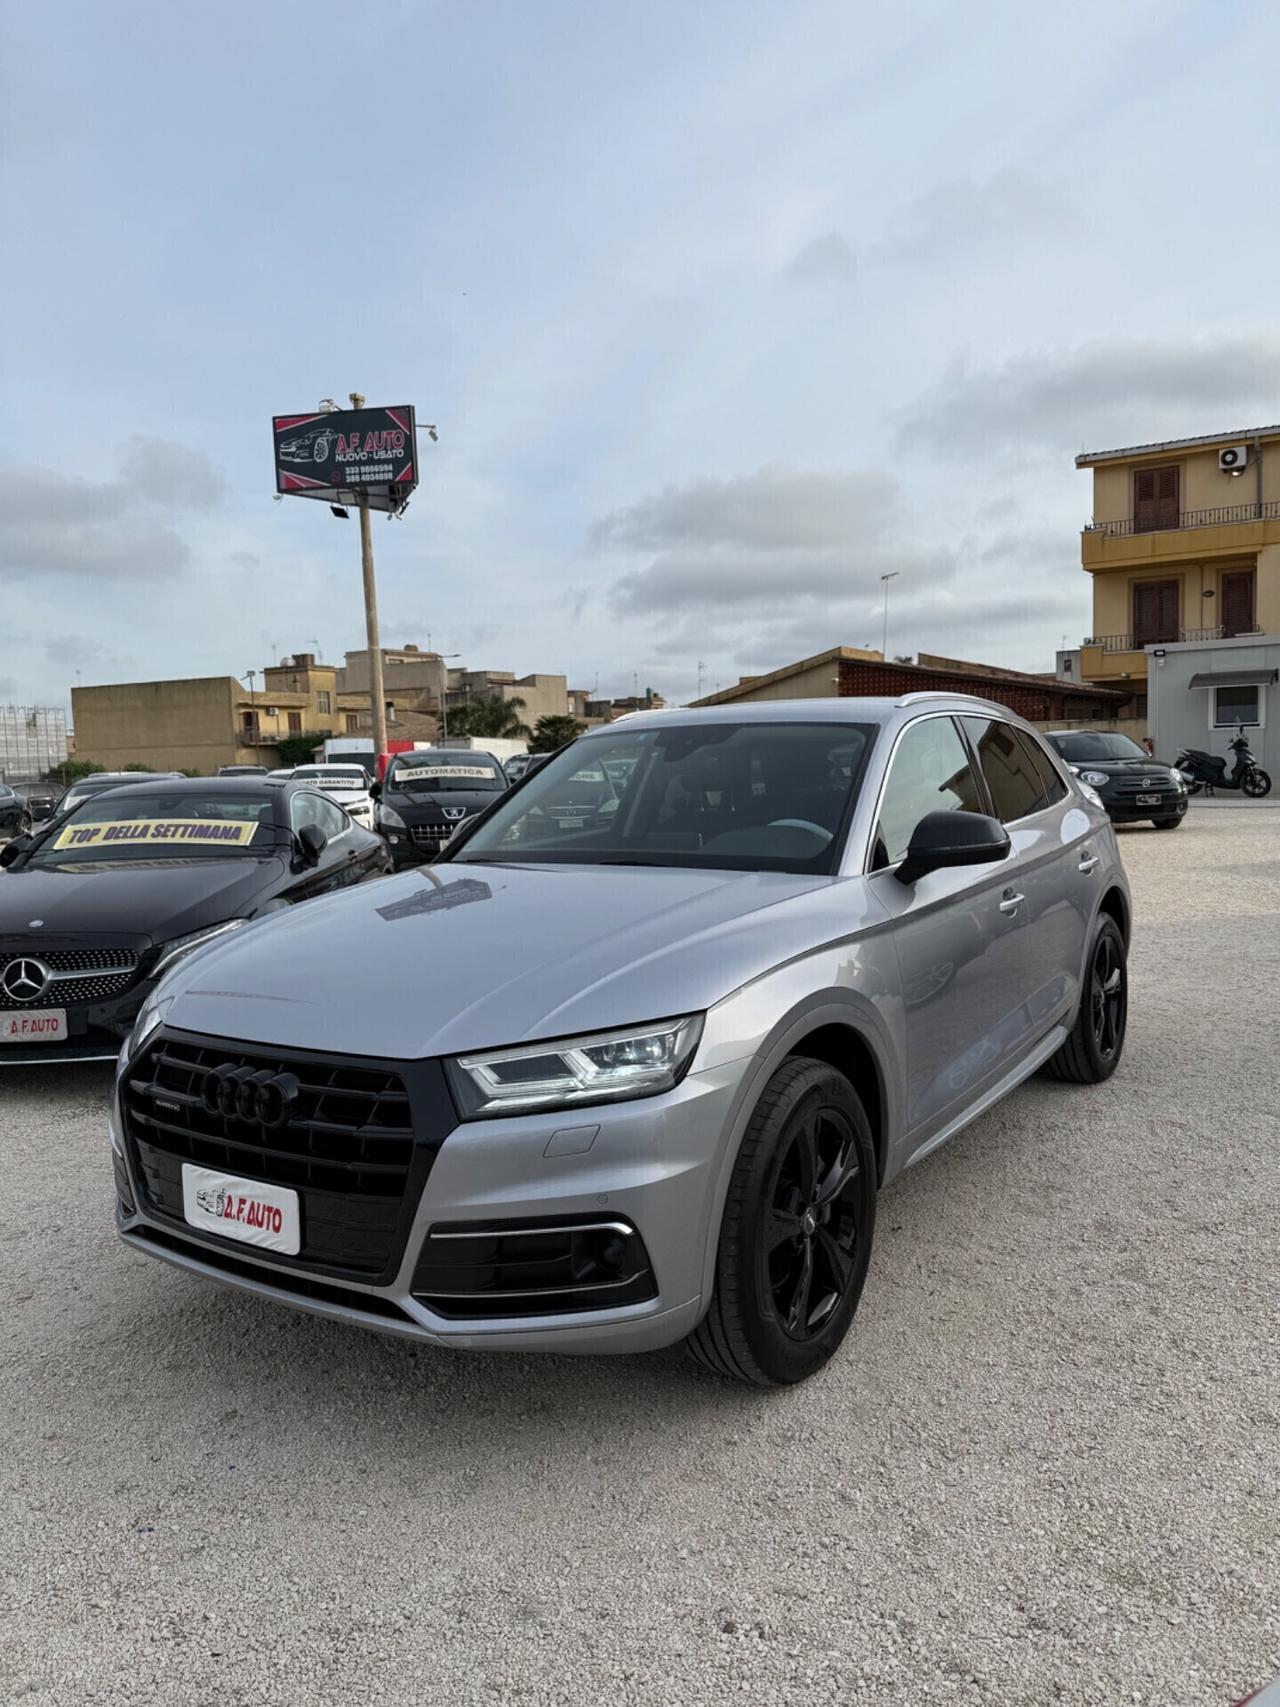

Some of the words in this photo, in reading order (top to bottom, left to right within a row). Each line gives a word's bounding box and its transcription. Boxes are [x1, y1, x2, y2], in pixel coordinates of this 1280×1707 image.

[363, 429, 405, 451] AUTO
[335, 452, 368, 462] NUOVO
[373, 449, 404, 459] USATO
[406, 768, 484, 777] AUTOMATICA
[68, 828, 101, 844] TOP
[102, 825, 150, 841] DELLA
[151, 823, 242, 840] SETTIMANA
